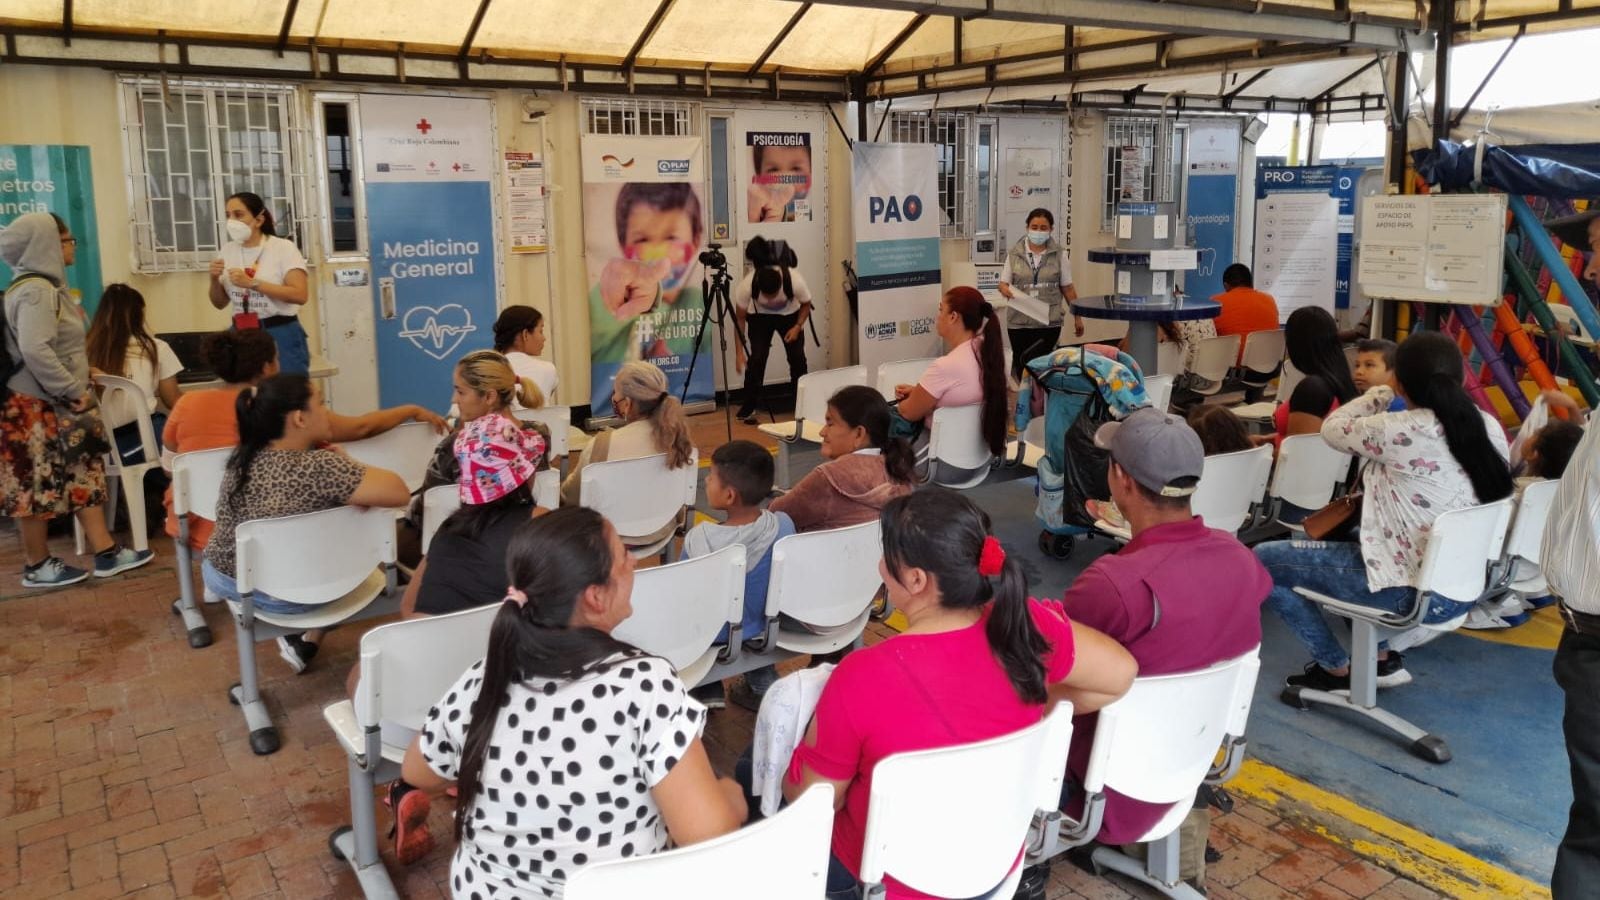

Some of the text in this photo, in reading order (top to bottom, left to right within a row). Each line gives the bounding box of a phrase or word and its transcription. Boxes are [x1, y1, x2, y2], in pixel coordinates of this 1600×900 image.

[753, 133, 804, 146] PSICOLOGÍA
[1264, 171, 1294, 182] PRO
[0, 178, 55, 193] etros
[869, 194, 923, 224] PAO
[383, 238, 480, 259] Medicina
[390, 258, 474, 279] General
[910, 326, 930, 336] LEGAL
